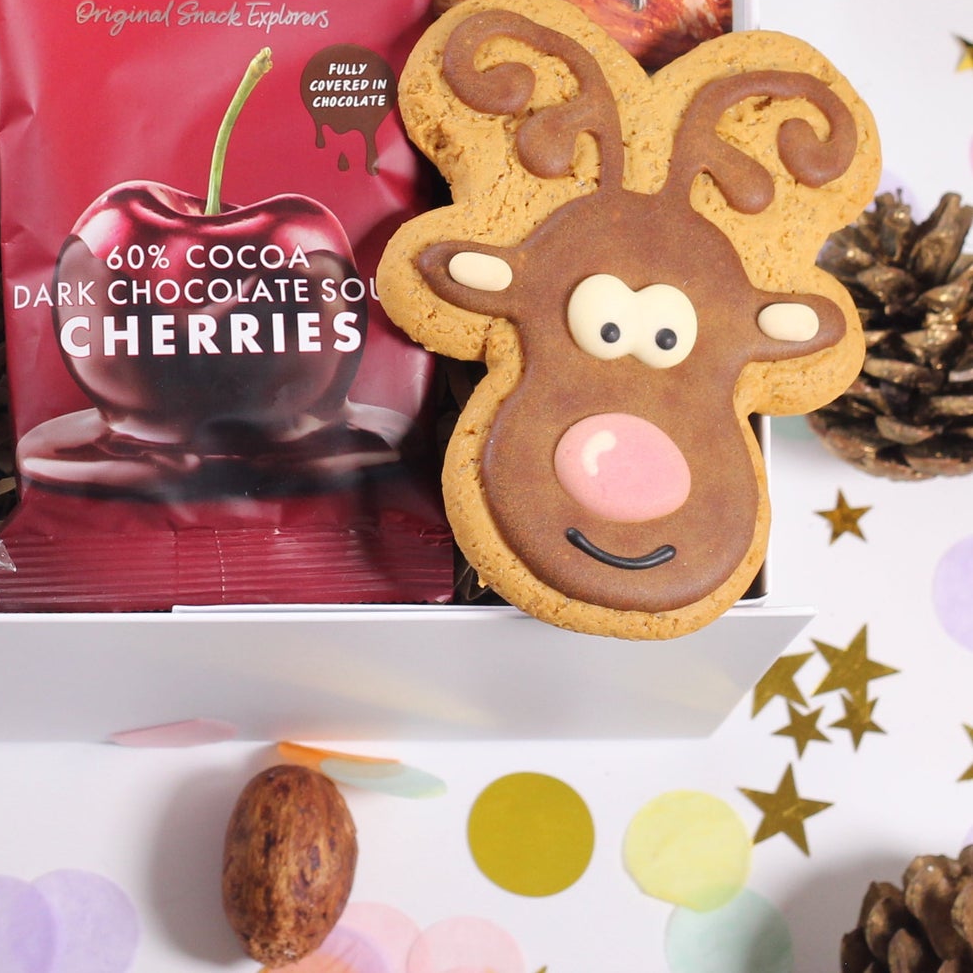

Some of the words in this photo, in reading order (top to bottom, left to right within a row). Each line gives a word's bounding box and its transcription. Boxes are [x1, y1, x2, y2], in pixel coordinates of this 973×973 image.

[76, 0, 174, 36] Original
[177, 0, 243, 27] Snack
[245, 1, 329, 34] Explorers
[328, 63, 368, 75] FULLY
[309, 78, 370, 92] COVERED
[372, 79, 387, 90] IN
[312, 95, 386, 108] CHOCOLATE
[105, 244, 170, 270] 60%
[185, 243, 311, 270] COCOA
[13, 280, 96, 310] DARK
[107, 277, 310, 306] CHOCOLATE
[59, 312, 363, 359] CHERRIES
